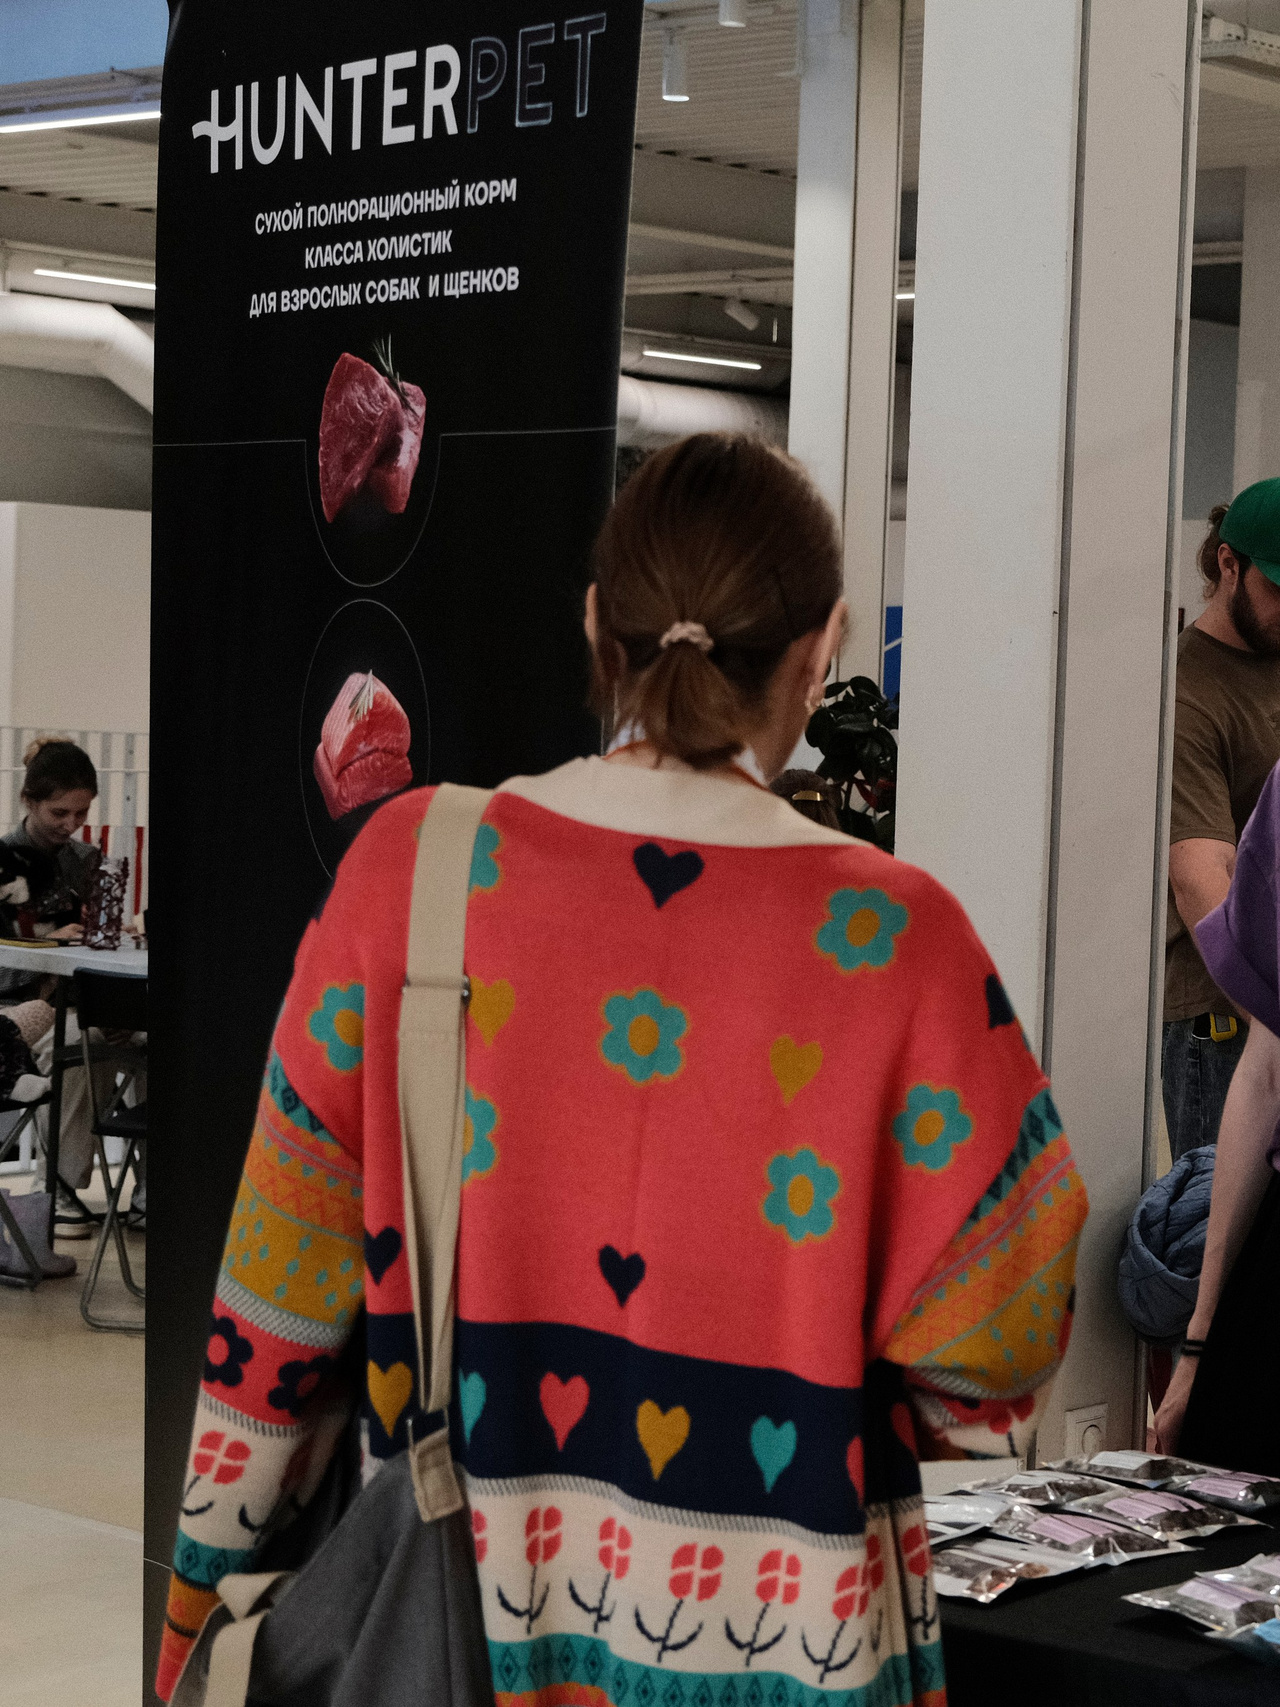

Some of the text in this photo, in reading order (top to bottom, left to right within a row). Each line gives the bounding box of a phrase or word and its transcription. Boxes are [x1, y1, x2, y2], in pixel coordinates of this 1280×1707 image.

[192, 13, 607, 173] HUNTERPET
[255, 178, 517, 235] СУХОЙ ПОЛНОРАЦИОННЫЙ КОРМ
[305, 229, 453, 269] КЛАССА ХОЛИСТИК
[249, 266, 520, 319] ДЛЯ ВЗРОСЛЫХ СОБАК И ЩЕНКОВ
